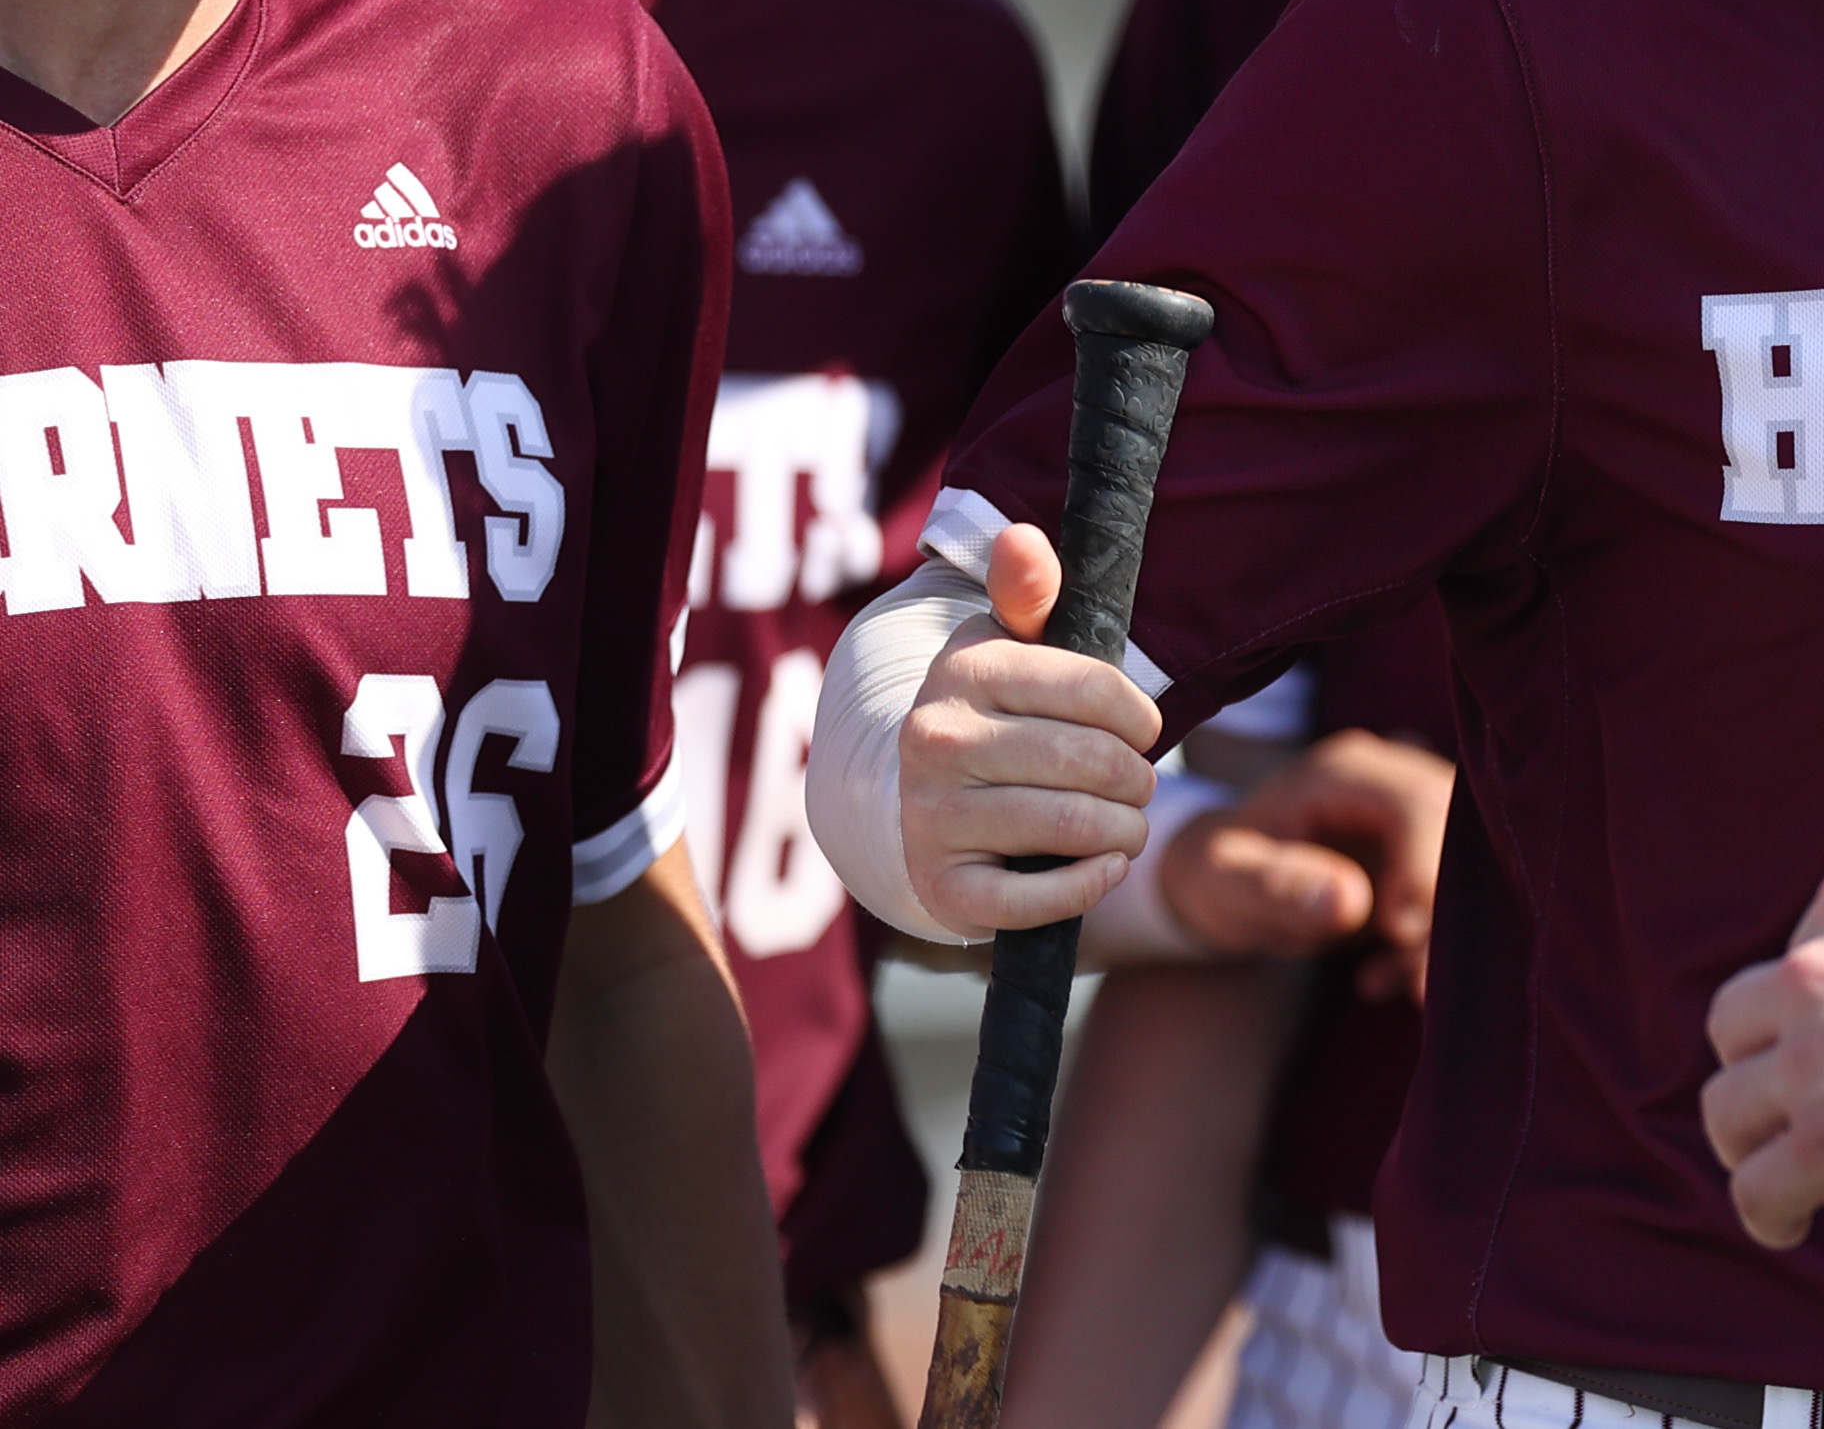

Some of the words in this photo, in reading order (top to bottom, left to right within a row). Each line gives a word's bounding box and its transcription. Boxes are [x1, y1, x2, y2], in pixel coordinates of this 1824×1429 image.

[353, 215, 459, 251] adidas
[0, 359, 566, 616] RNETS
[340, 673, 561, 983] 26
